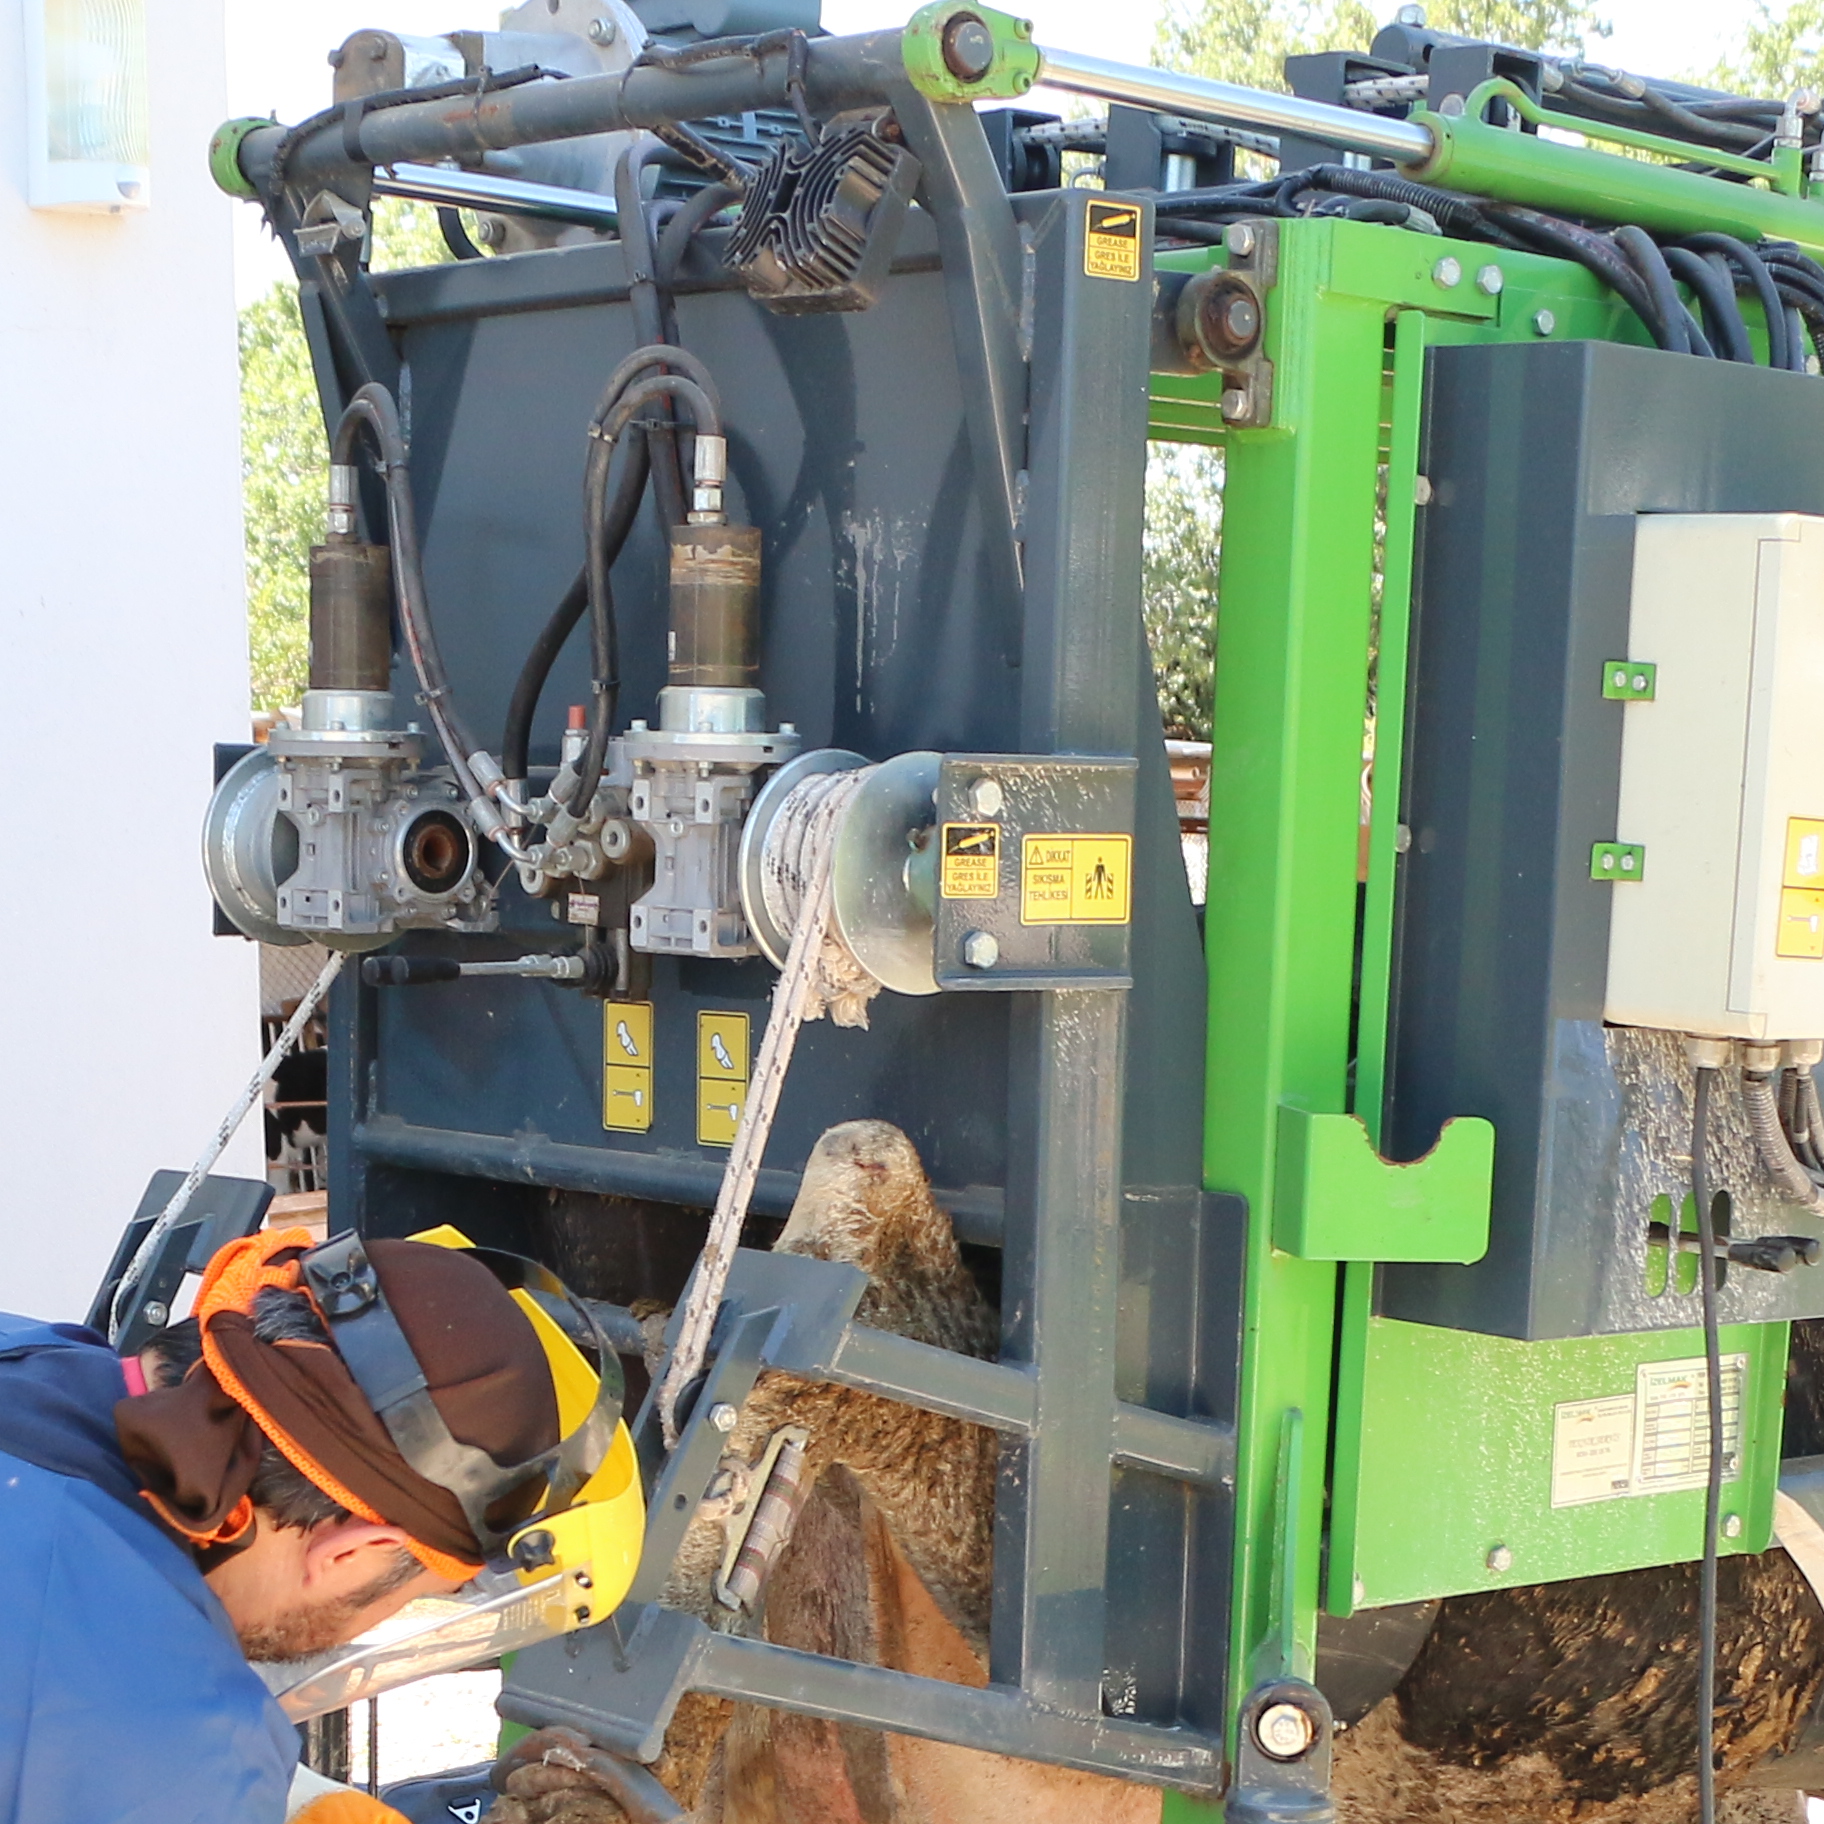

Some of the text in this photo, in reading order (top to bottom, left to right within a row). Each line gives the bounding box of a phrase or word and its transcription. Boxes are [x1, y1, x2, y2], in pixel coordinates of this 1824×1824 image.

[1097, 236, 1128, 249] GREASE
[1095, 250, 1116, 262] GRES
[954, 858, 987, 867] GREASE
[1045, 849, 1070, 864] DİKKAT
[952, 872, 975, 882] GRES
